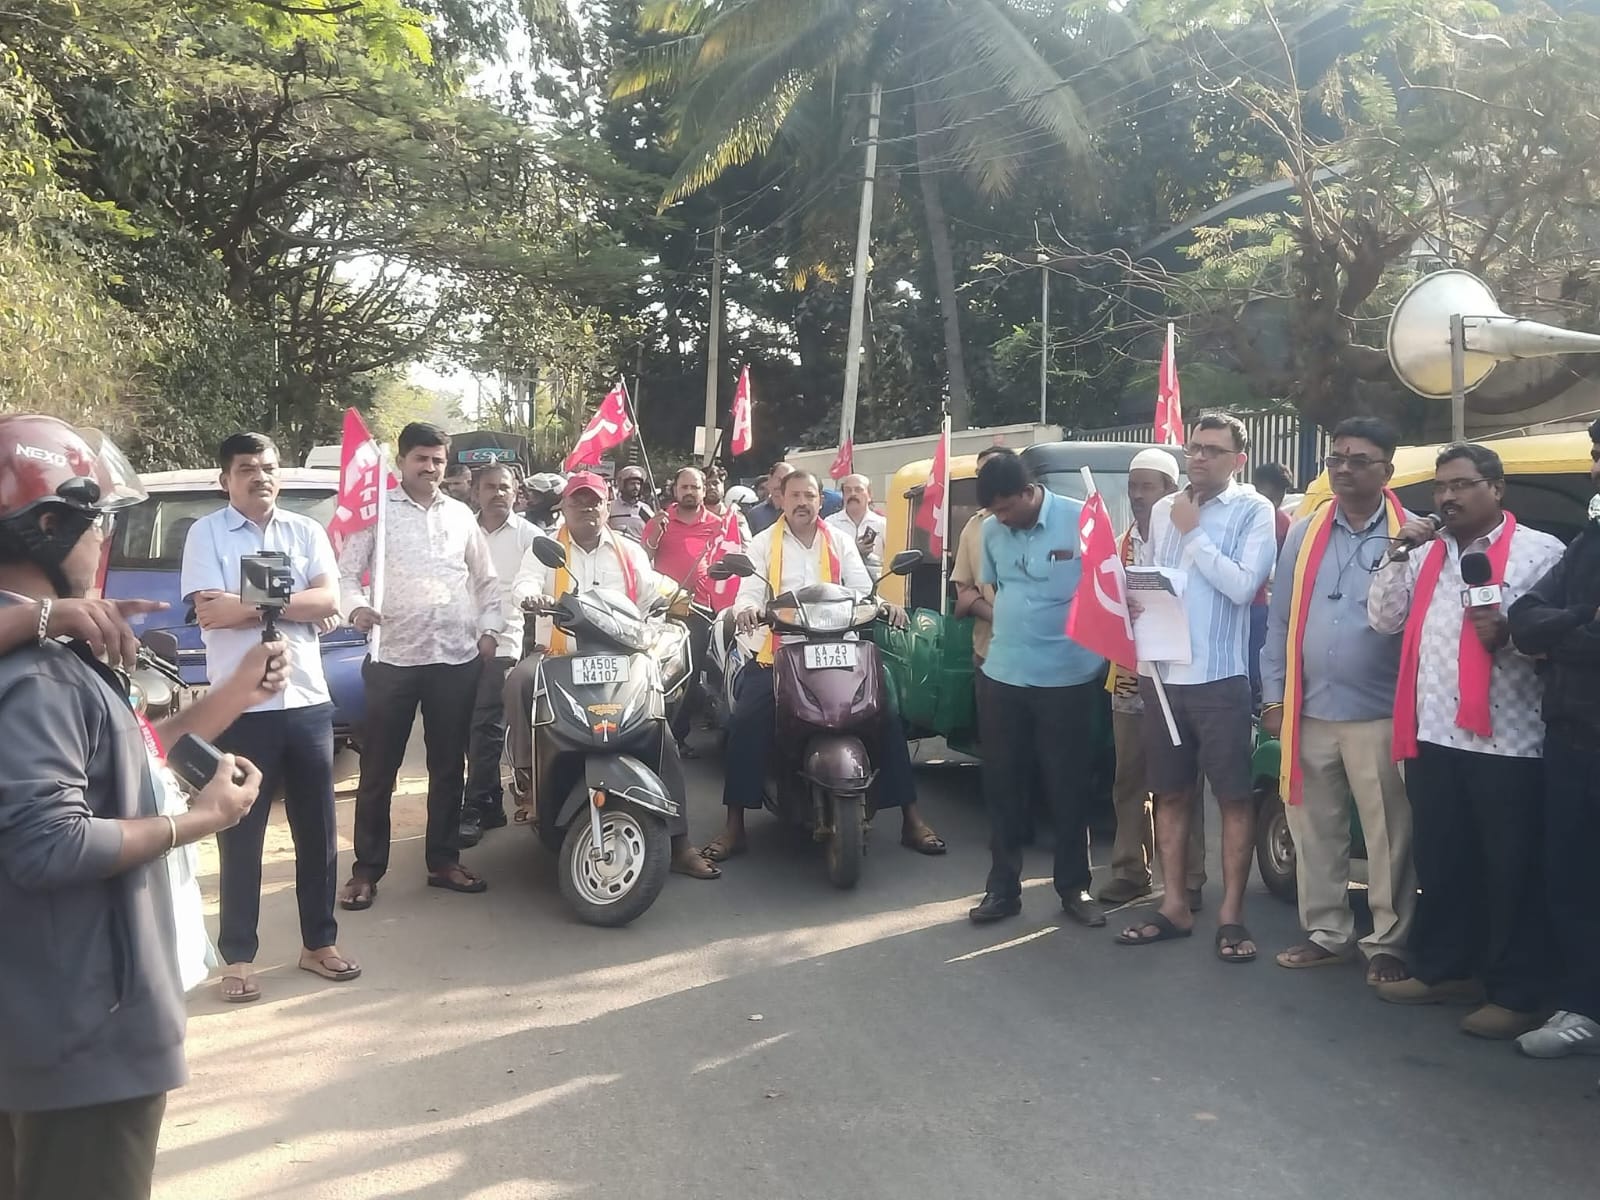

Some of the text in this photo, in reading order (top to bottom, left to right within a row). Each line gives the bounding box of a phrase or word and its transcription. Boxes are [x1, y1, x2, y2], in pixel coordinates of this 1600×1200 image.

[815, 645, 847, 656] KA 43
[582, 659, 617, 671] KA50E
[815, 656, 847, 666] R1761
[583, 670, 618, 682] N4107
